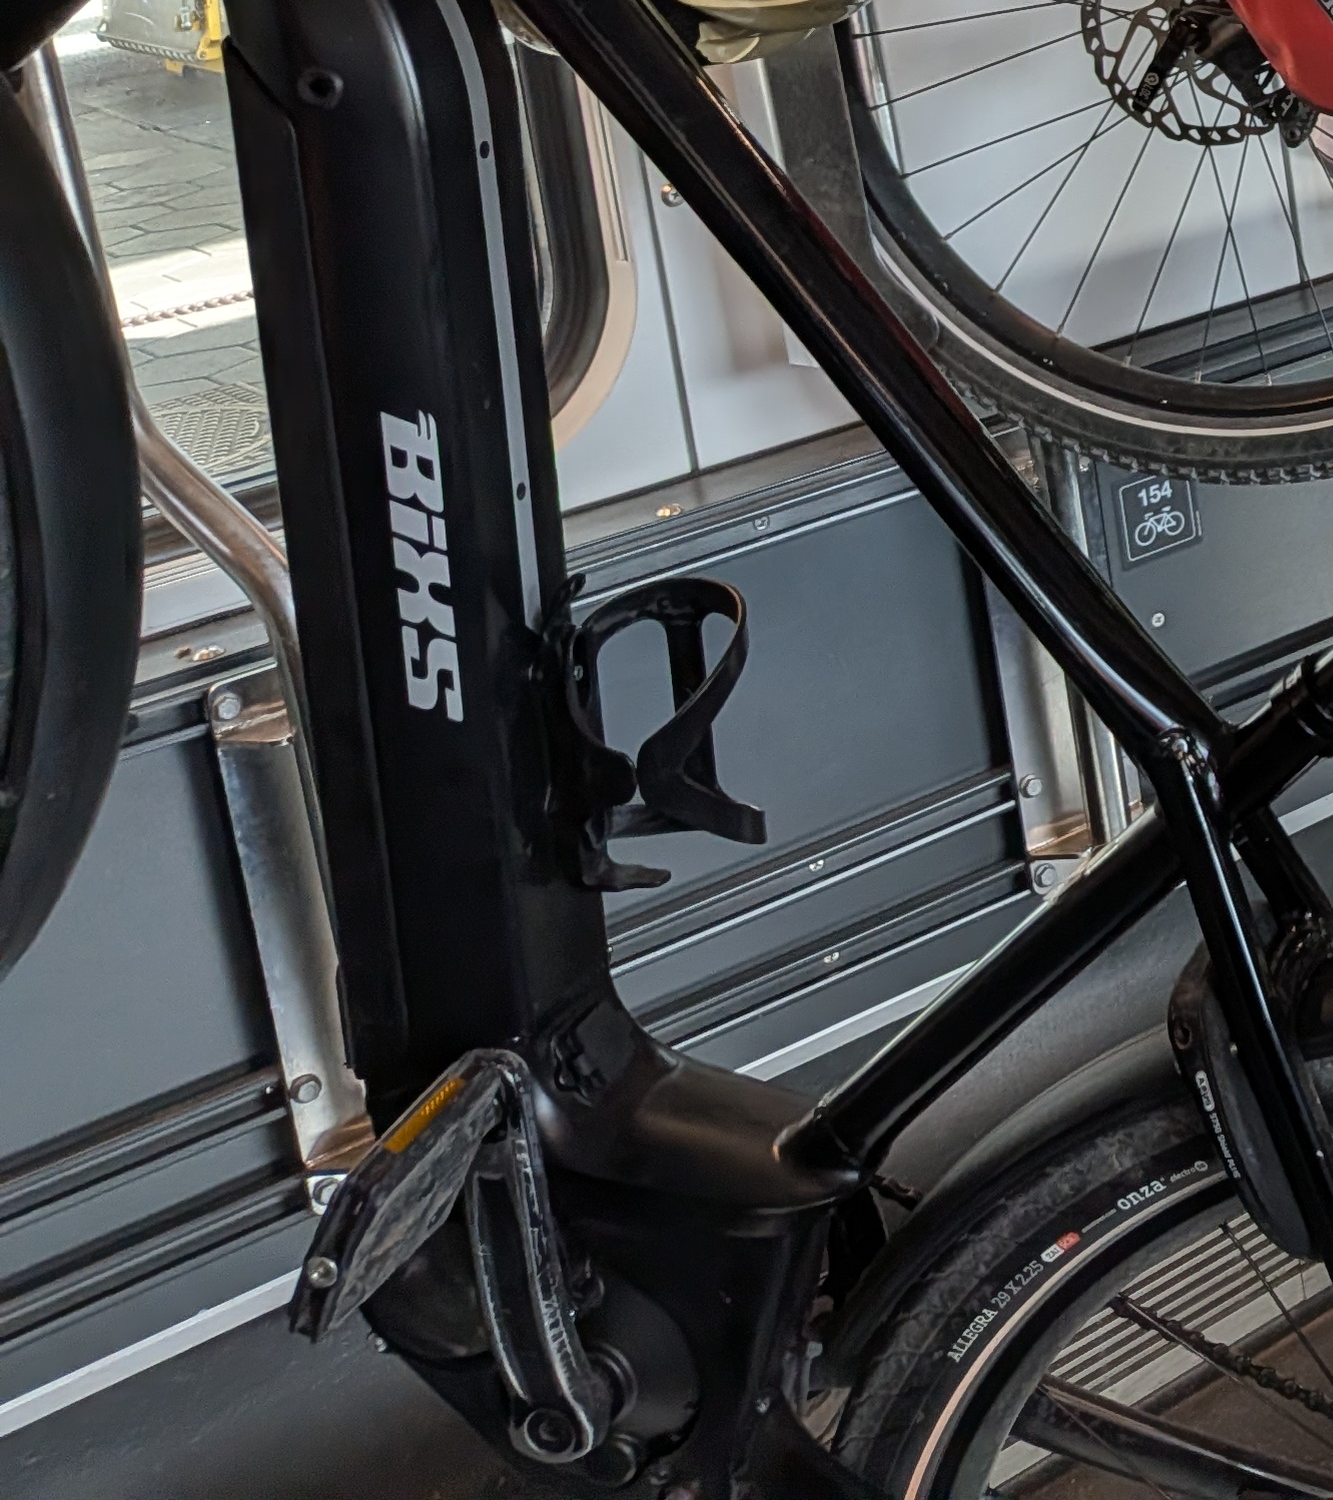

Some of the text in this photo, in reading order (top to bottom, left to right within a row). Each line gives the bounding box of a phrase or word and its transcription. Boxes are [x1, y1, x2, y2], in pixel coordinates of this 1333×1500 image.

[1138, 479, 1173, 507] 154
[1117, 1179, 1166, 1211] onza
[947, 1308, 998, 1363] ALLEGRA
[991, 1290, 1011, 1309] 29
[1015, 1260, 1044, 1286] 2.25
